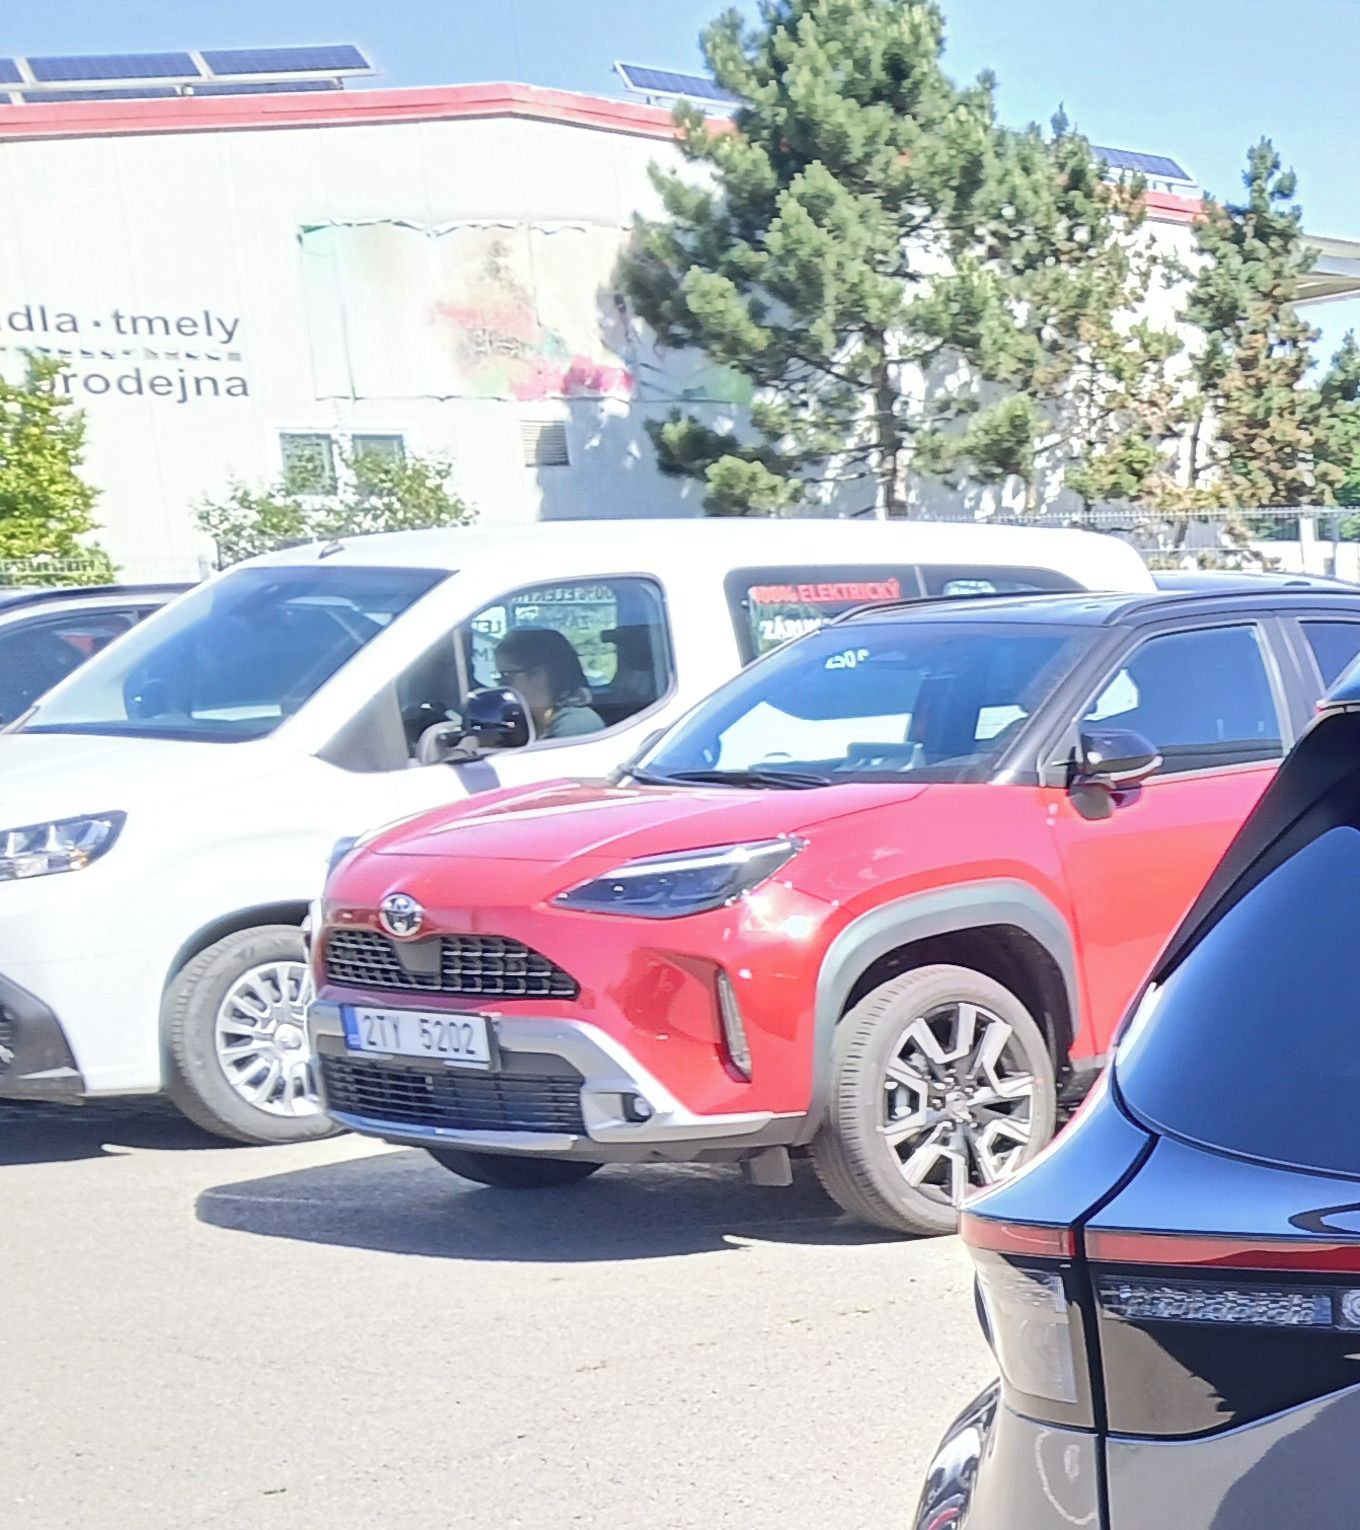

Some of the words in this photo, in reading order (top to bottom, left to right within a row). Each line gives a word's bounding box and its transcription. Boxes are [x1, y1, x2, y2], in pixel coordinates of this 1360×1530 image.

[0, 305, 79, 334] dla
[112, 309, 239, 344] tmely
[419, 1018, 476, 1055] 5202
